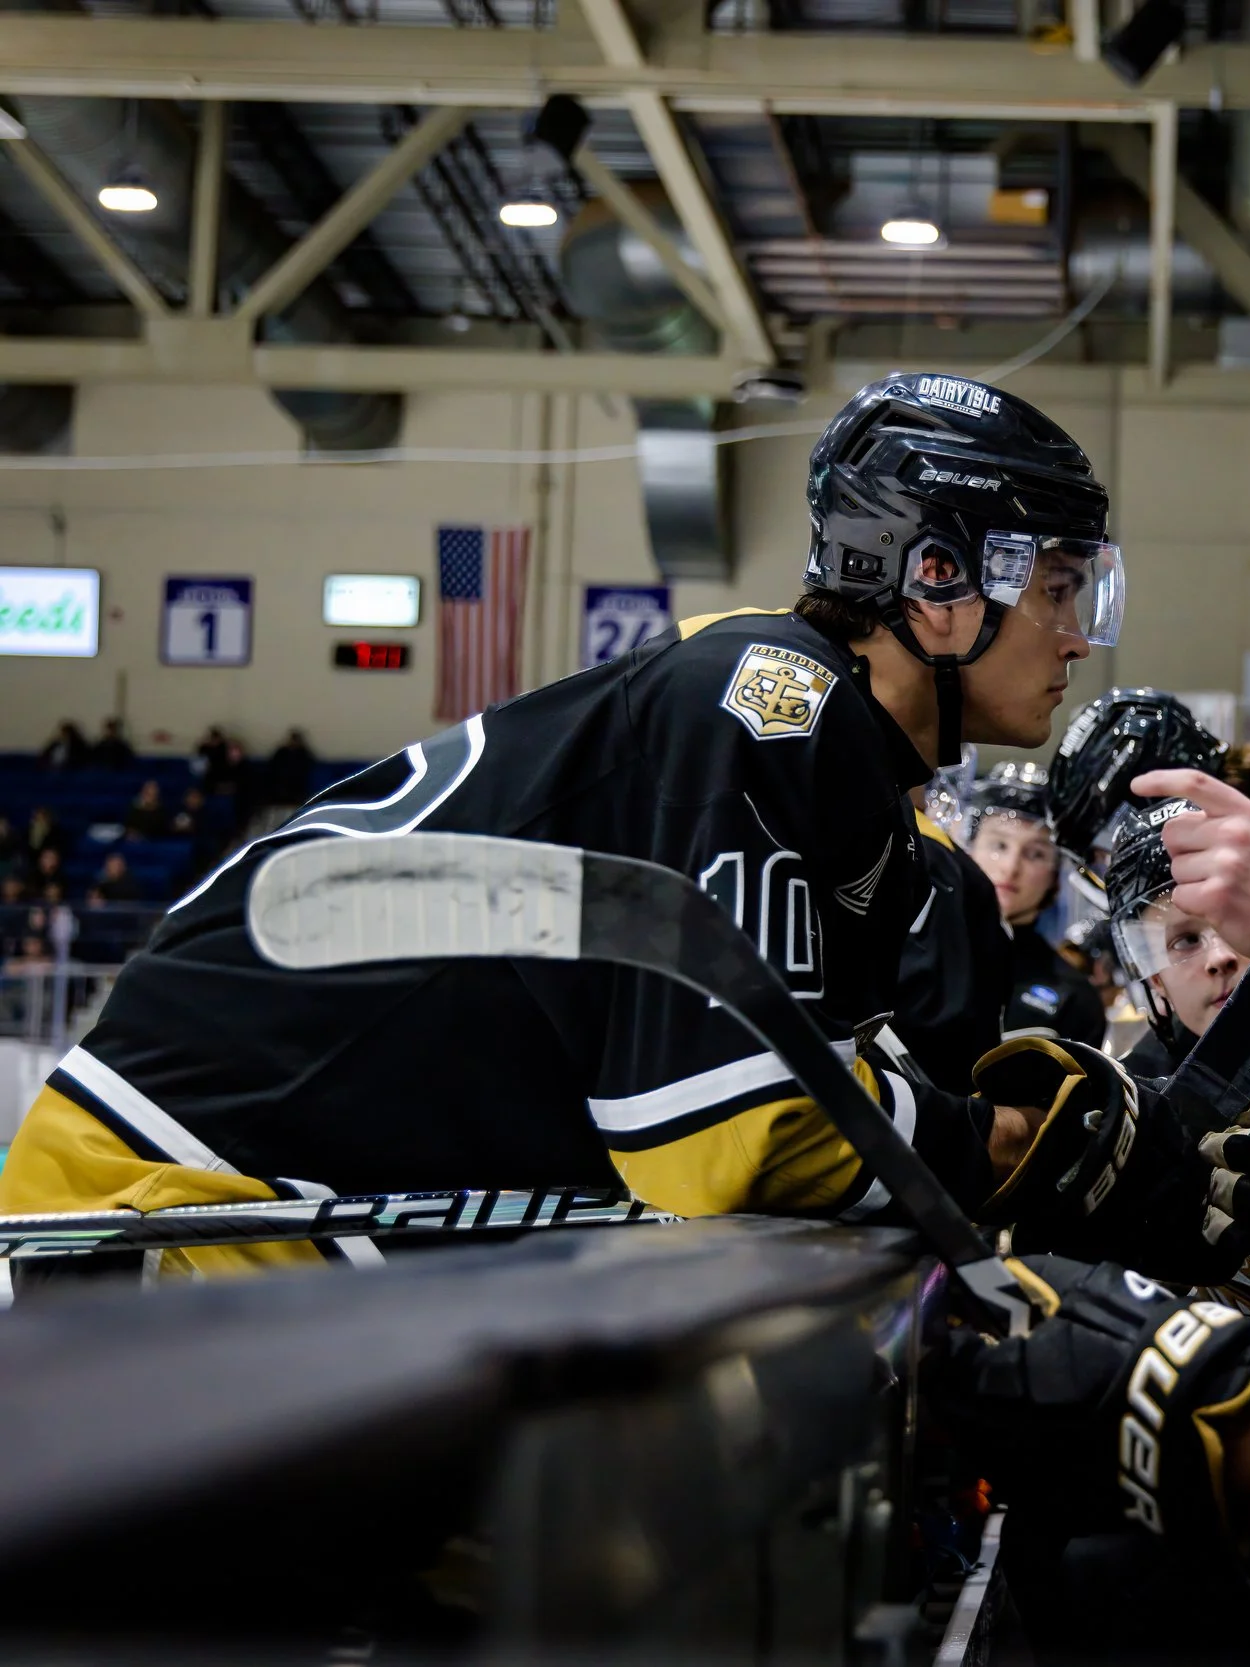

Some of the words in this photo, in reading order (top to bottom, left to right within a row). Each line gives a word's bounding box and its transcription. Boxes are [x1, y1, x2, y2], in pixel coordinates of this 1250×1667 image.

[918, 377, 968, 405] DAIRY
[200, 611, 216, 660] 1
[751, 645, 834, 682] ISLANDERS
[700, 850, 825, 1008] 10
